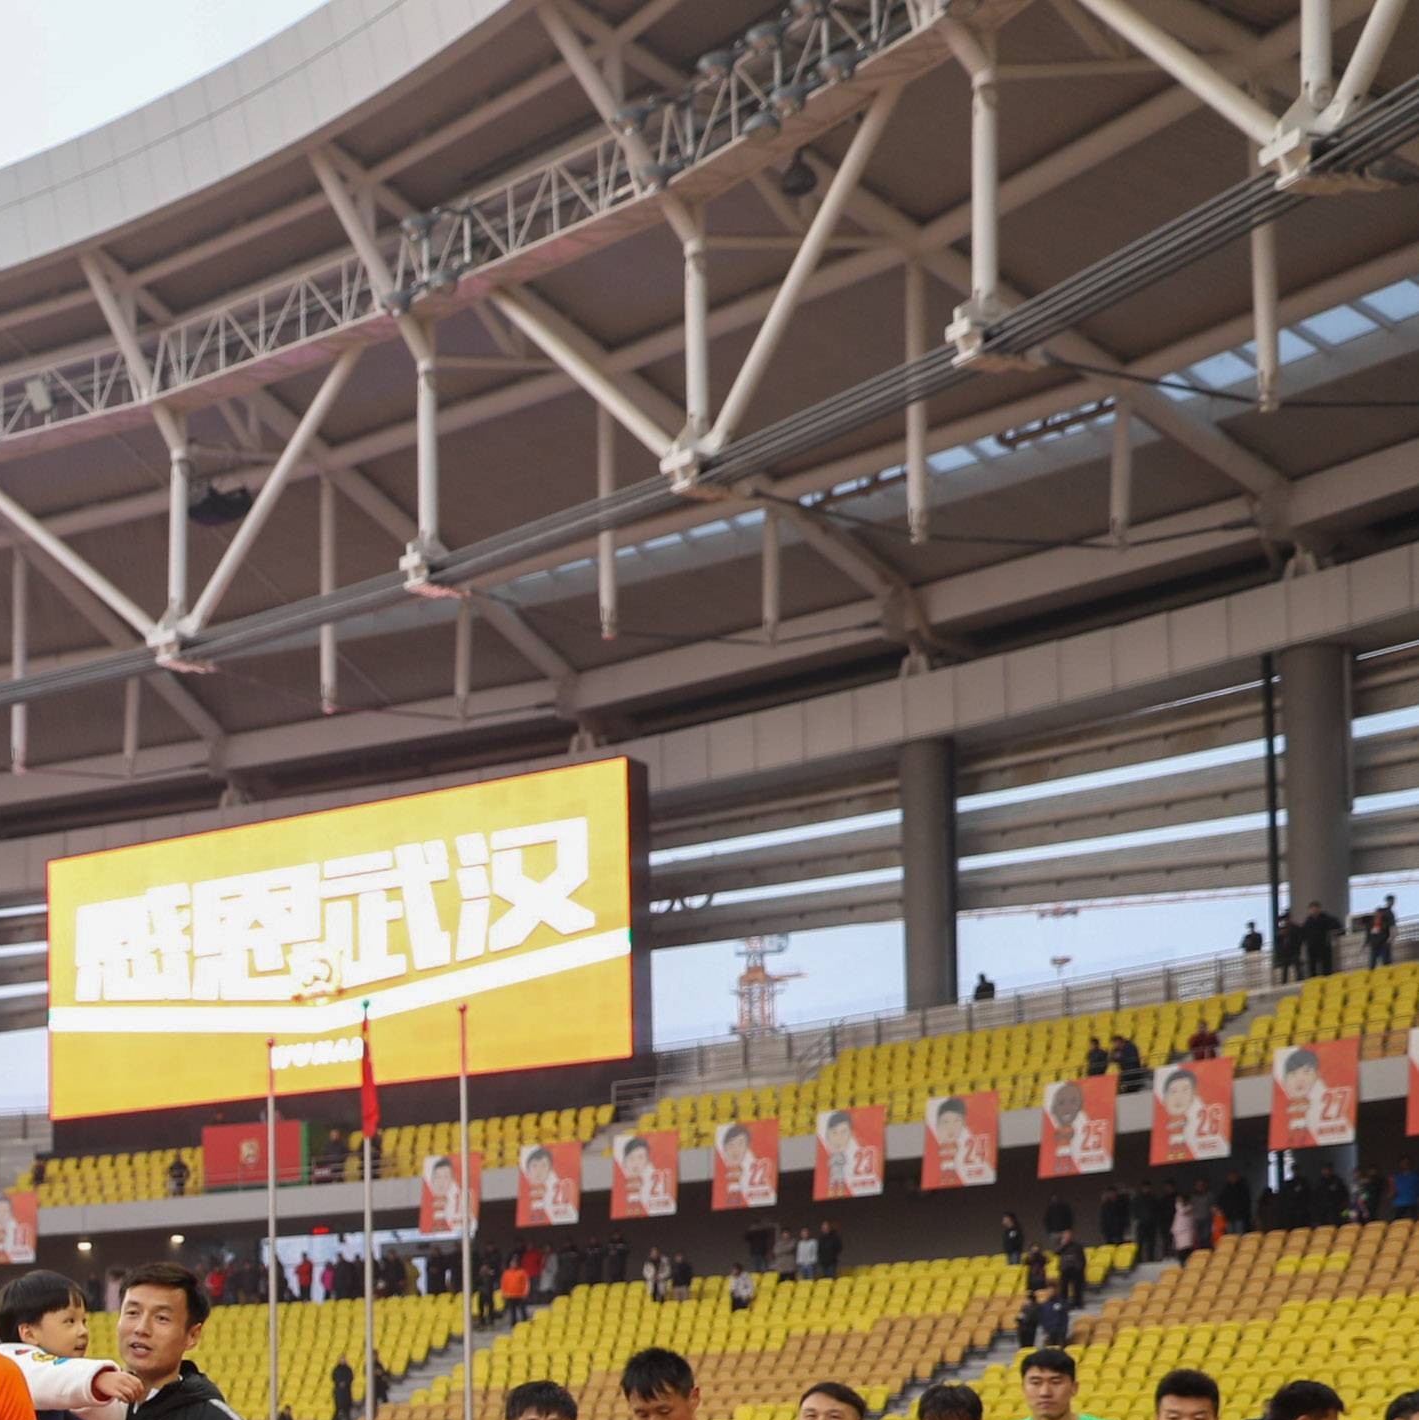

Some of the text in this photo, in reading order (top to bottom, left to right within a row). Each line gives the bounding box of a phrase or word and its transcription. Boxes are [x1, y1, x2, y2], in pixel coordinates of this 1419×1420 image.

[75, 817, 595, 1001] 感恩武汉
[1321, 1087, 1351, 1120] 27
